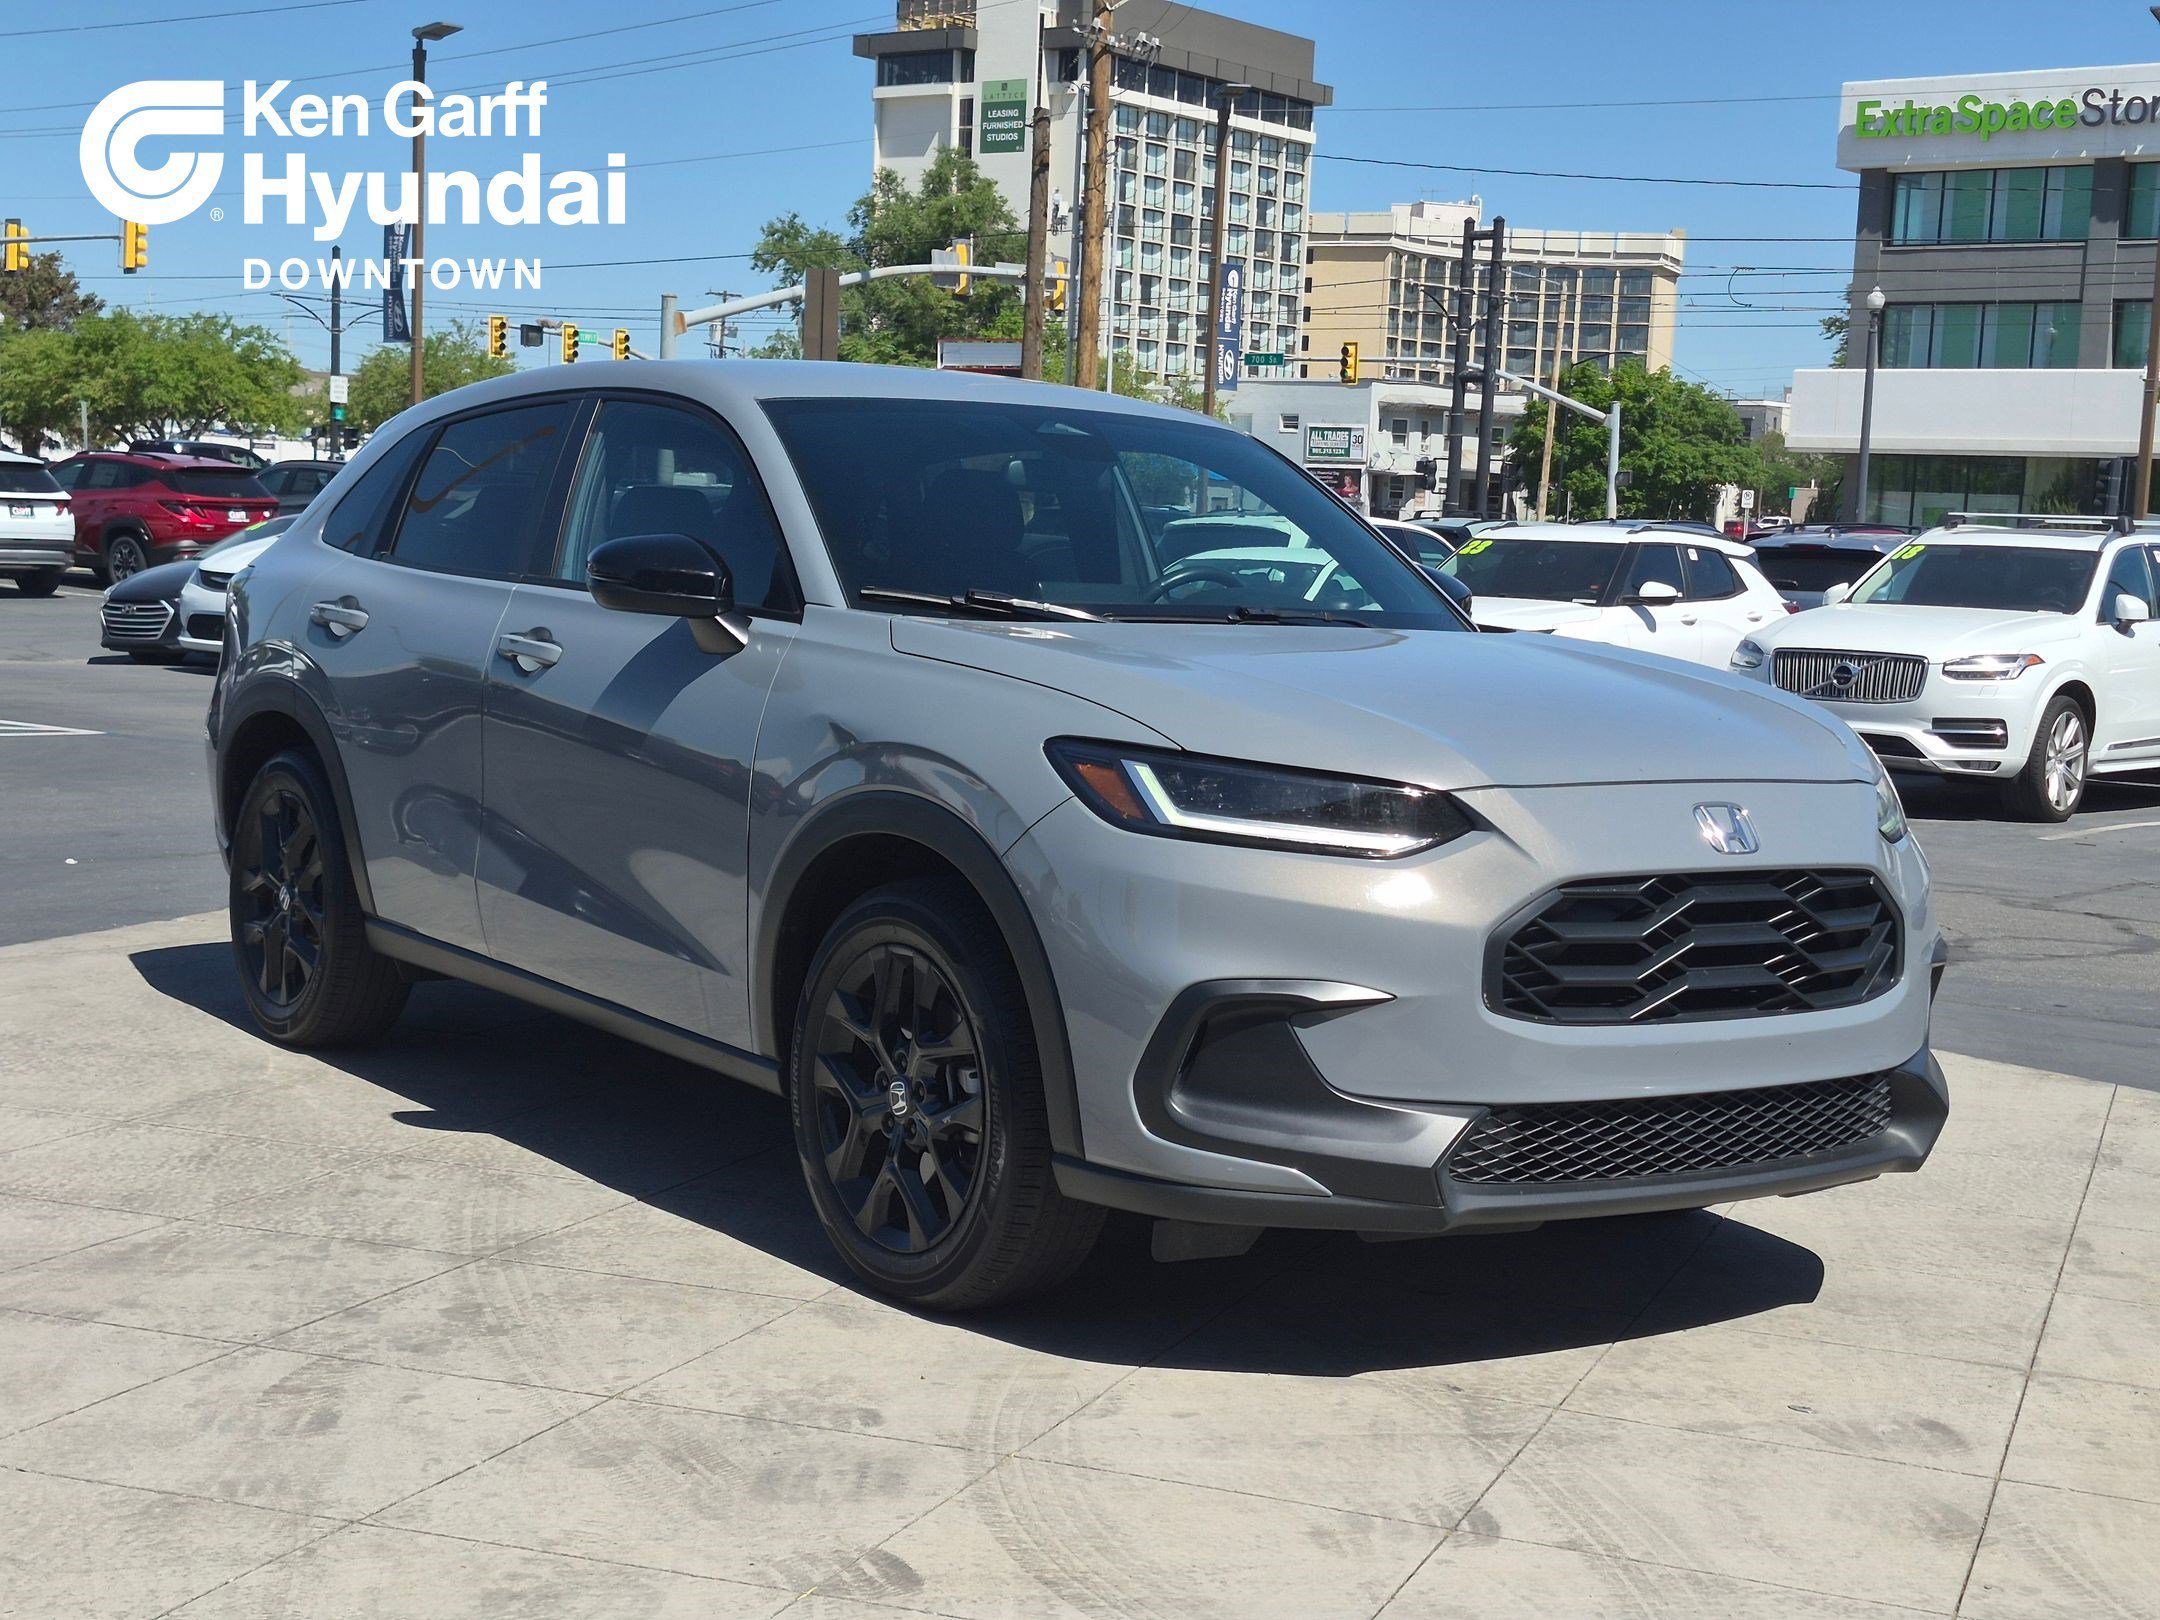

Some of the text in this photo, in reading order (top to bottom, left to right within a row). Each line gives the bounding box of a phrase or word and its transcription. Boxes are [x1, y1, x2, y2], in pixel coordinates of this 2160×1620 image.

[983, 92, 1025, 100] LATTICE
[988, 109, 1019, 118] LEASING
[982, 121, 1024, 130] FURNISHED
[986, 133, 1019, 141] STUDIOS
[1224, 288, 1232, 333] Hyundai
[1251, 355, 1265, 364] 700
[1310, 431, 1349, 440] ALL TRADES
[1352, 435, 1364, 444] 30
[1459, 540, 1494, 555] 23
[1891, 545, 1926, 560] 18
